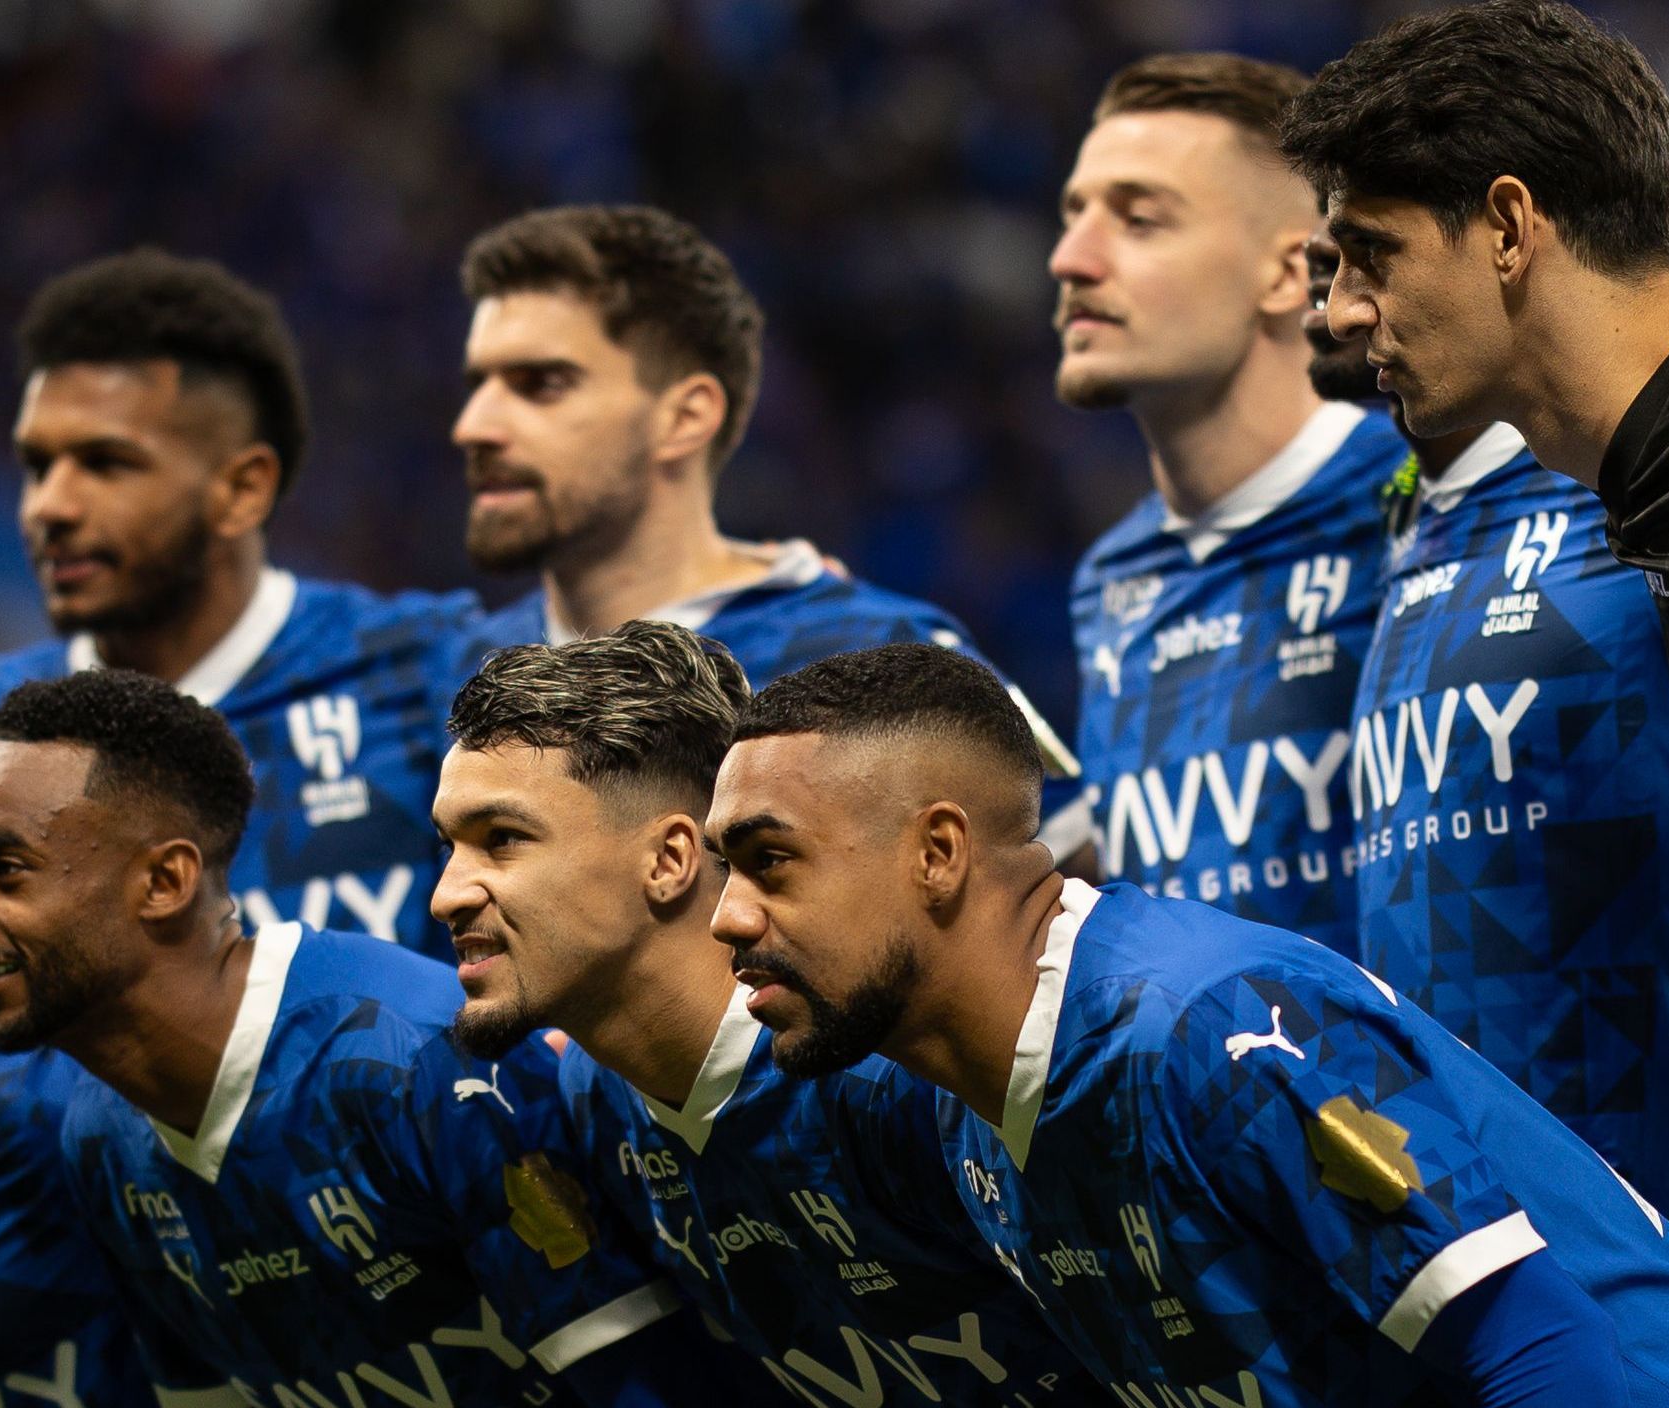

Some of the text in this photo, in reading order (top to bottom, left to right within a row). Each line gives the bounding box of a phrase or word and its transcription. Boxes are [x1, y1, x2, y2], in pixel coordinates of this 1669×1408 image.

[1346, 677, 1540, 822] AVVY
[1089, 729, 1350, 878] AVVY
[1404, 801, 1548, 851] GROUP
[219, 1247, 311, 1296] jahez
[1039, 1239, 1106, 1287] jahez
